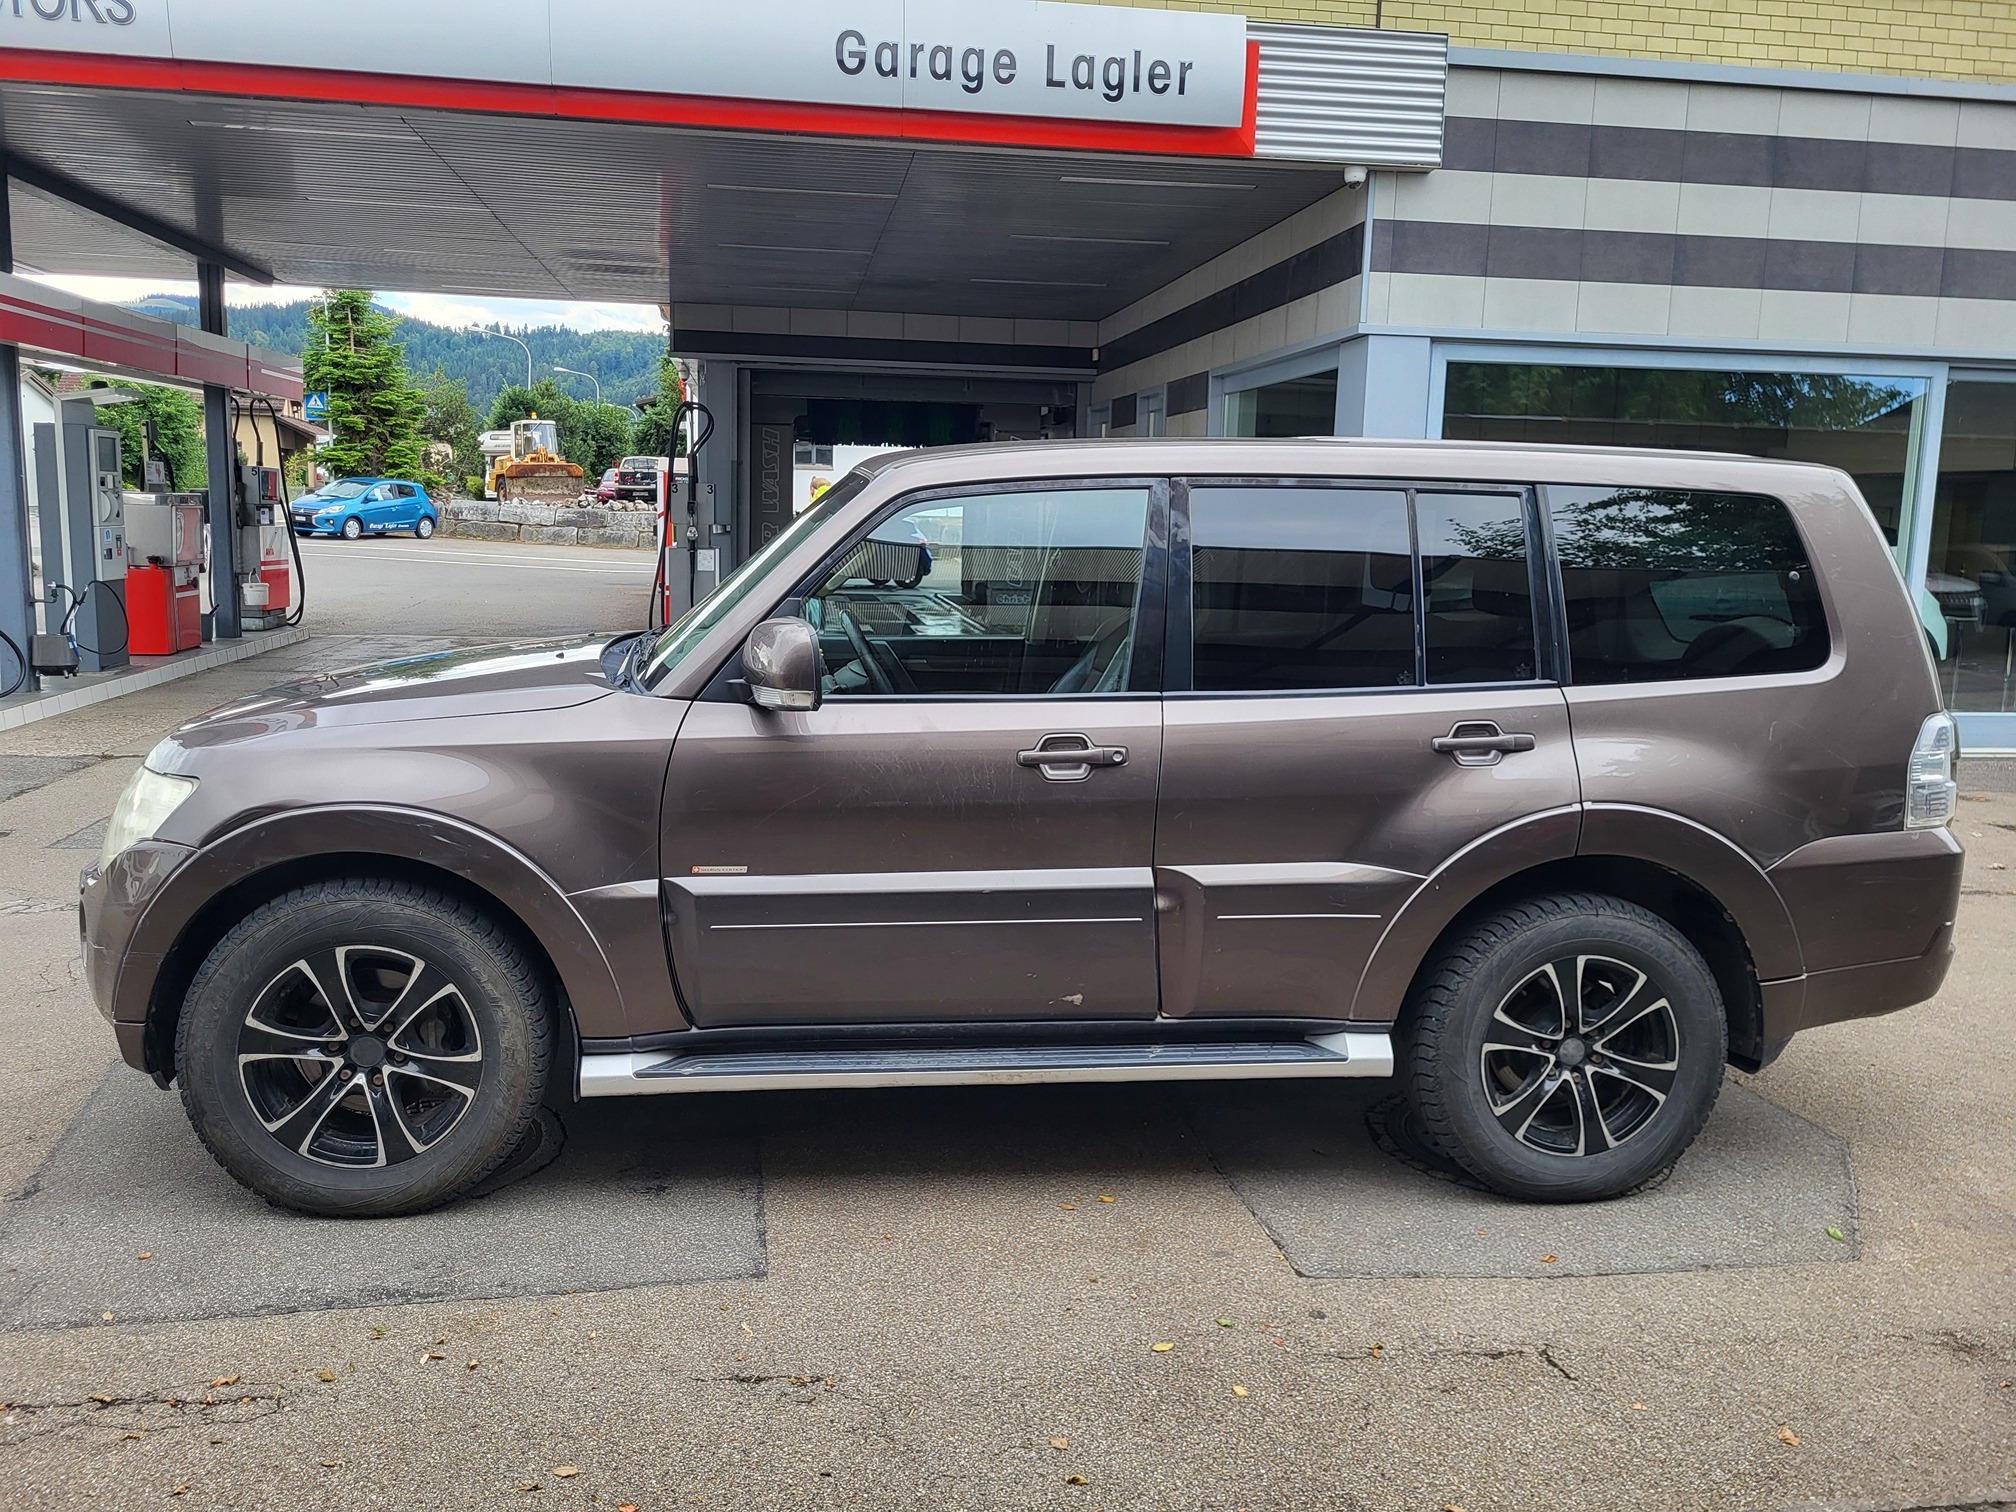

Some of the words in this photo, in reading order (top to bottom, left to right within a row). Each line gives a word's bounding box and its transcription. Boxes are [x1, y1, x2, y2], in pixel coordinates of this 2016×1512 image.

[835, 29, 1018, 94] Garage
[1045, 43, 1194, 103] Lagler
[251, 468, 257, 476] 5
[762, 427, 780, 513] WASH
[671, 484, 679, 493] 3
[706, 485, 714, 494] 3
